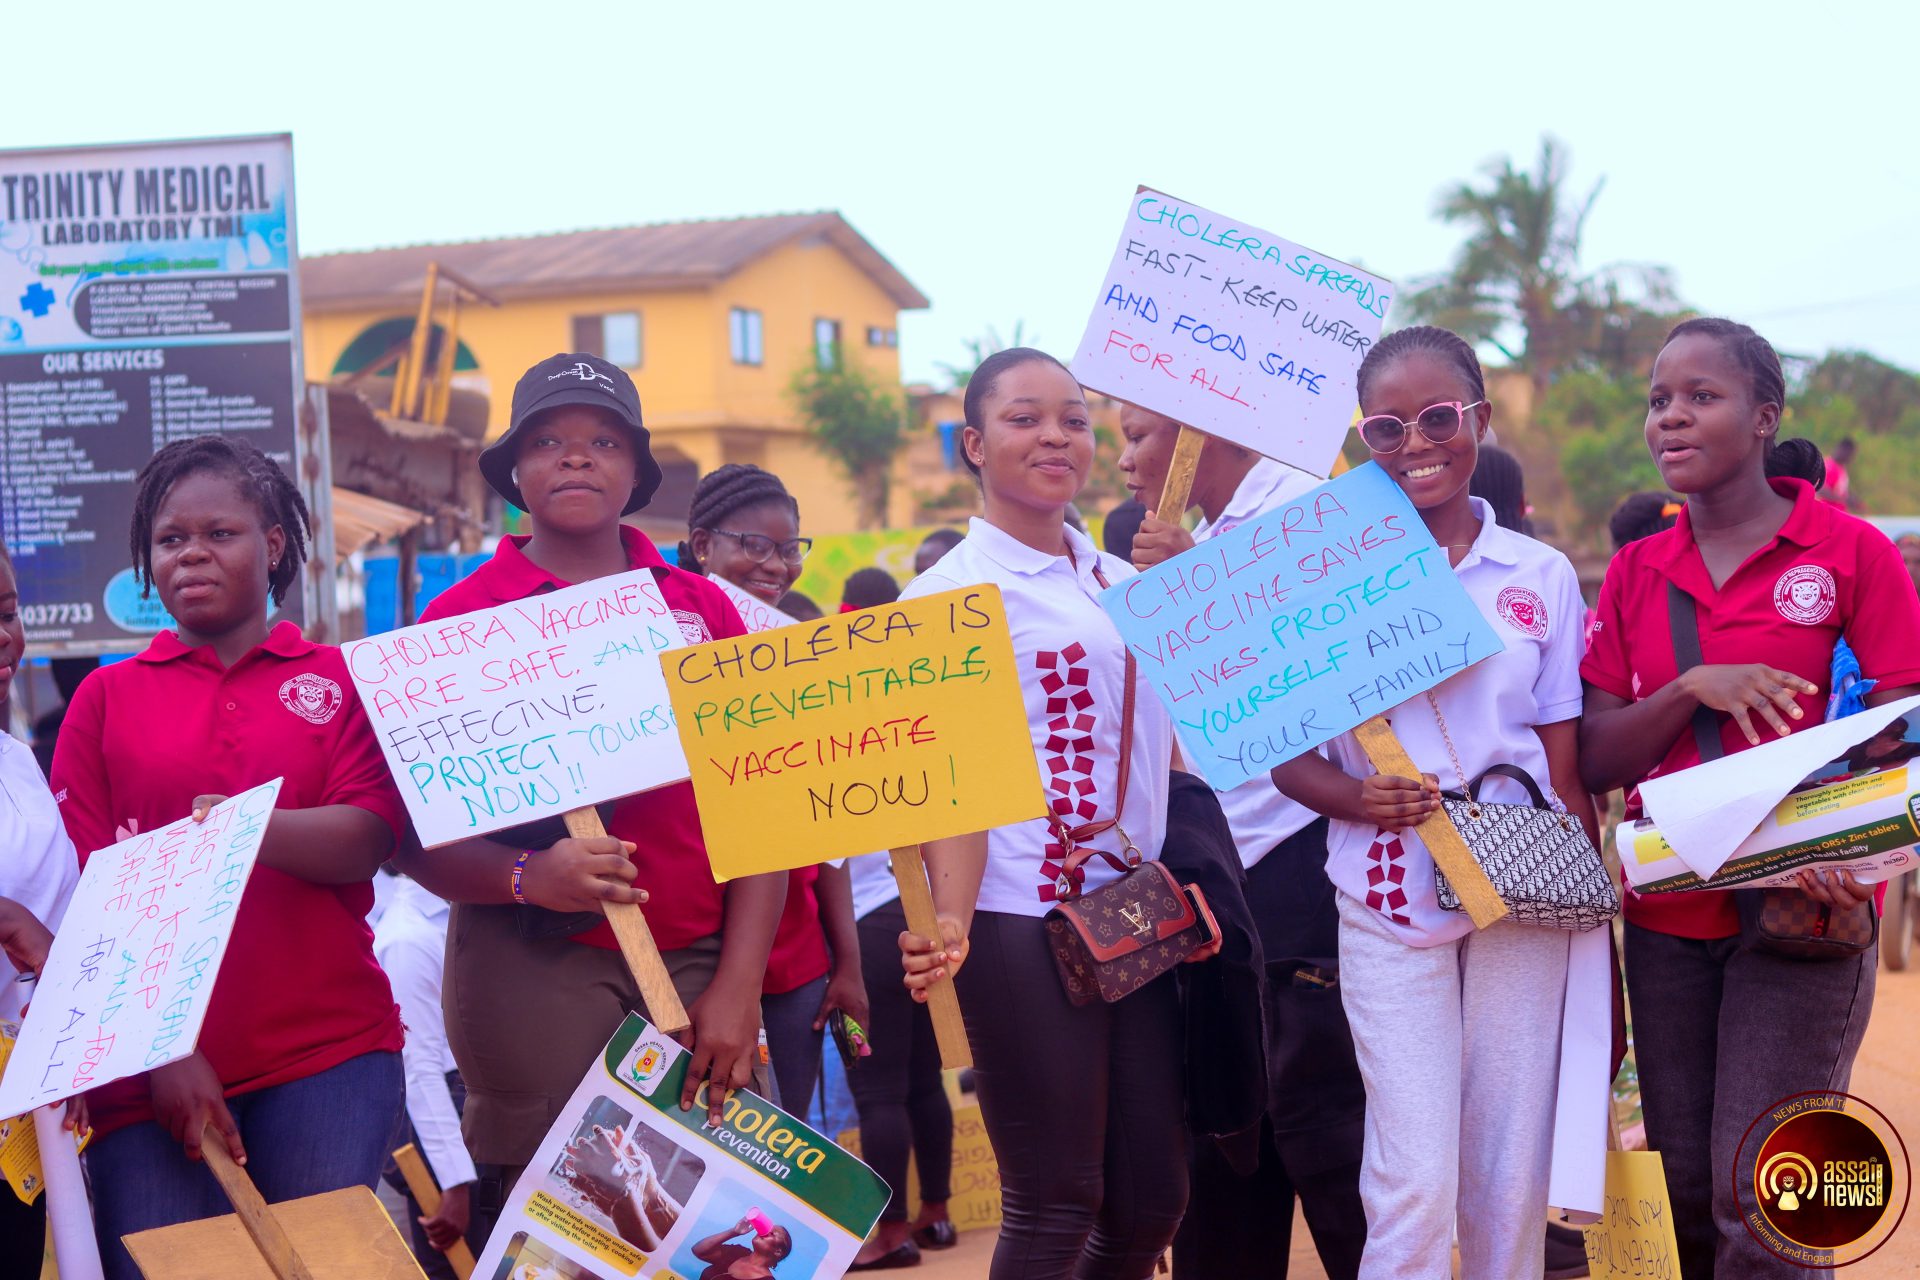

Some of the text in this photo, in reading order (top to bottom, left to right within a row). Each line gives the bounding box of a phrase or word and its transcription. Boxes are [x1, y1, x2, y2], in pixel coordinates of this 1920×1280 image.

[3, 164, 270, 223] TRINITY MEDICAL
[42, 220, 194, 246] LABORATORY
[1137, 198, 1389, 318] CHOLERA SPREADS
[1221, 277, 1297, 317] KEEP
[43, 349, 164, 374] OUR SERVICES
[1104, 284, 1326, 395] AND FOOD SAFE
[1104, 330, 1250, 407] FOR ALL
[1302, 312, 1371, 360] WATER
[1125, 492, 1348, 618] CHOLERA
[18, 603, 94, 626] 037733
[1134, 515, 1406, 667] VACCINE SAVES
[350, 616, 515, 684] CHOLERA
[515, 583, 667, 639] VACCINES
[679, 611, 923, 683] CHOLERA
[949, 594, 990, 633] IS
[373, 673, 464, 718] ARE
[594, 626, 669, 666] AND
[694, 646, 991, 736] PREVENTABLE,
[1180, 607, 1442, 746] YOURSELF AND
[1218, 632, 1471, 775] YOUR FAMILY
[409, 735, 559, 803] PROTECT
[710, 715, 936, 785] VACCINATE
[1796, 789, 1832, 802] Thoroughly
[1833, 785, 1850, 793] wash
[1796, 797, 1831, 809] vegetables
[1833, 792, 1846, 800] with
[1797, 802, 1840, 817] before eating
[104, 837, 153, 911] SAFE
[1658, 883, 1674, 891] you
[1674, 876, 1695, 886] have
[1721, 860, 1763, 875] diarrhoea,
[1764, 853, 1785, 863] start
[1786, 844, 1821, 857] drinking
[1822, 838, 1846, 849] ORS+
[1848, 833, 1868, 842] Zinc
[1869, 823, 1900, 837] tablets
[1701, 871, 1751, 888] immediately
[1780, 855, 1812, 867] nearest
[1813, 849, 1839, 859] health
[1840, 844, 1868, 856] facility
[72, 821, 197, 1088] WATER AND FOOD
[135, 907, 189, 1009] KEEP
[144, 786, 275, 1066] CHOLERA SPREADS
[73, 934, 115, 991] FOR
[532, 1201, 553, 1216] running
[554, 1213, 571, 1226] water
[571, 1223, 590, 1238] before
[612, 1247, 634, 1264] cooking
[536, 1210, 550, 1221] after
[551, 1219, 571, 1236] visiting
[571, 1232, 581, 1241] the
[582, 1239, 598, 1251] toilet
[537, 1192, 642, 1261] Wash your hands with soap under safe
